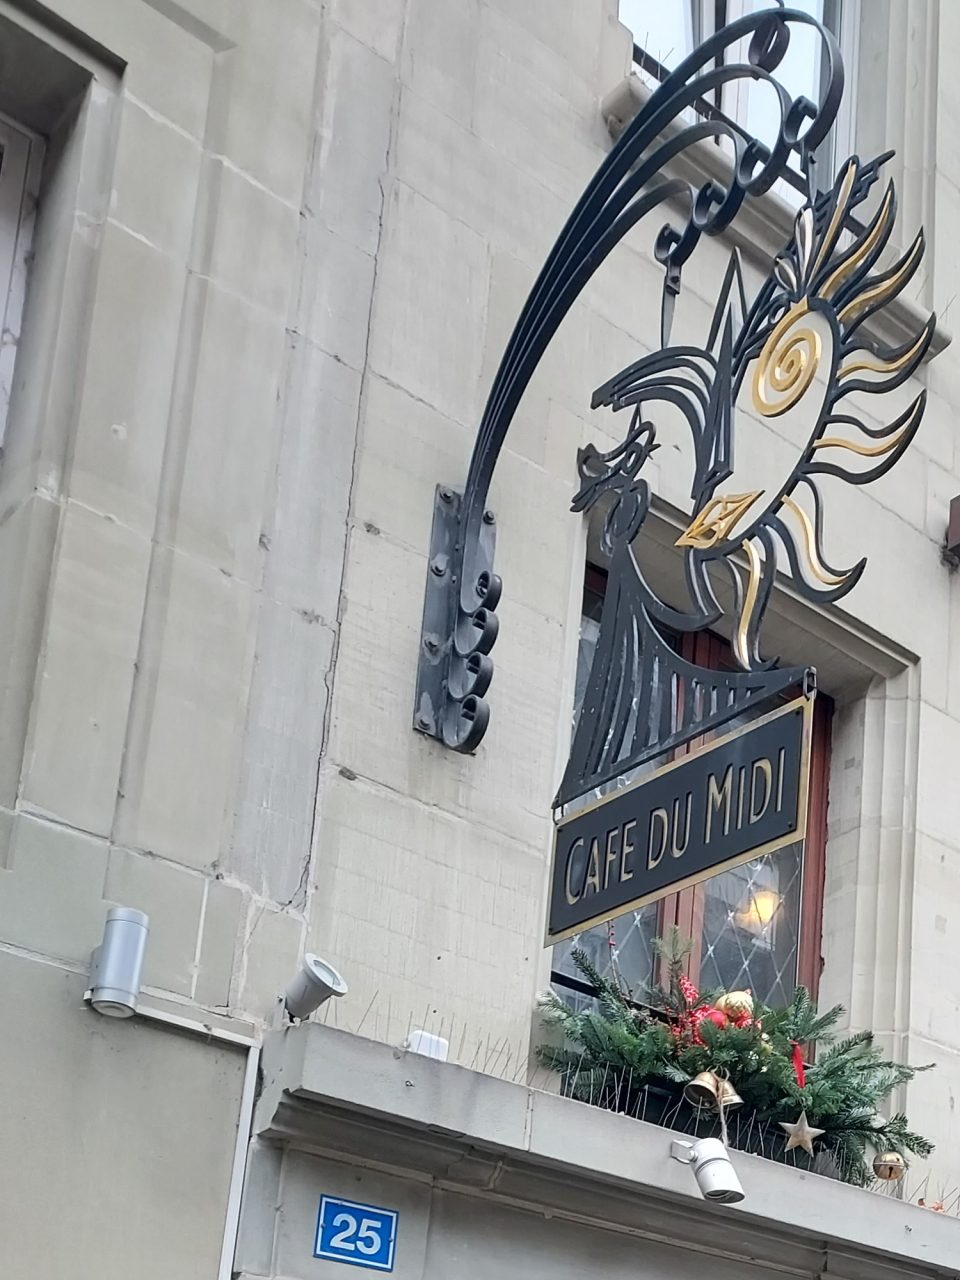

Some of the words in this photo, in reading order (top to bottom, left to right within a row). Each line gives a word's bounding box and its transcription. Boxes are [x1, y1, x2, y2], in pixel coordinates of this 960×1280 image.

[564, 818, 637, 905] CAFE
[648, 791, 692, 870] DU
[703, 746, 785, 844] MIDI
[329, 1213, 382, 1255] 25
